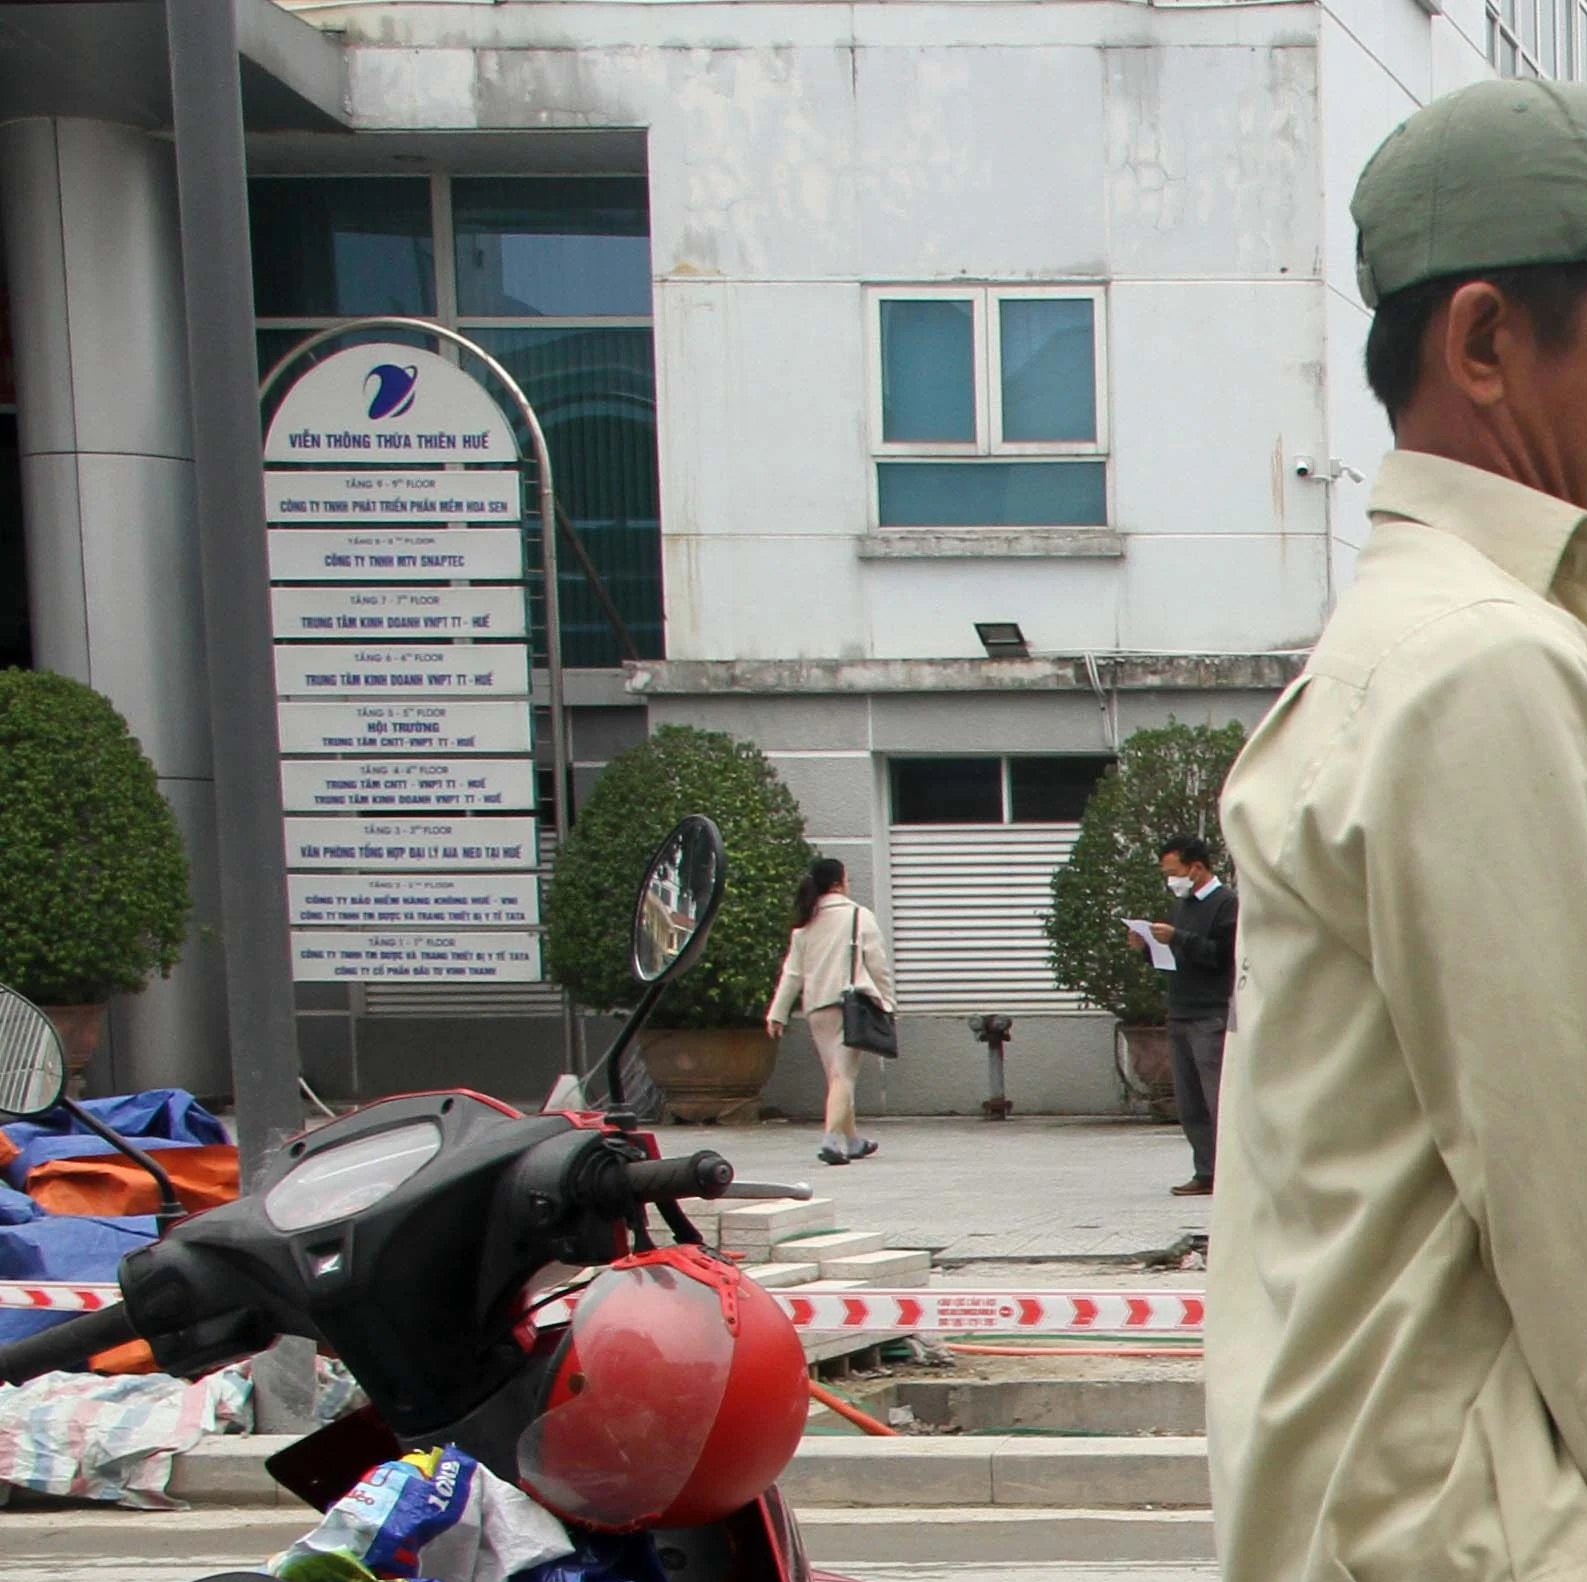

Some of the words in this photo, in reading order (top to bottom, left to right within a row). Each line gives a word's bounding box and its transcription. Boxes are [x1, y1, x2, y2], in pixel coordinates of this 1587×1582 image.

[290, 429, 320, 448] VIỄN
[326, 431, 371, 448] THÔNG
[377, 432, 412, 448] THỪA
[417, 431, 456, 448] THIÊN
[463, 430, 490, 448] HUẾ
[407, 480, 435, 488] FLOOR
[281, 498, 306, 512] CÔNG
[310, 501, 320, 512] TY
[324, 501, 348, 512] TNHH
[353, 497, 377, 512] PHÁT
[467, 501, 485, 512] HOA
[489, 501, 507, 512] SEN
[325, 553, 351, 567] CÔNG
[355, 555, 365, 567] TY
[370, 555, 394, 567] TNHH
[397, 555, 417, 567] MTV
[421, 555, 464, 567] SNAPTEC
[302, 617, 333, 628] TRUNG
[337, 614, 357, 628] TÂM
[360, 617, 384, 628] KINH
[388, 617, 420, 628] DOANH
[452, 617, 461, 628] TT
[473, 614, 490, 628] HUẾ
[306, 675, 336, 686] TRUNG
[341, 673, 361, 686] TÂM
[364, 675, 387, 686] KINH
[391, 675, 423, 686] DOANH
[428, 675, 451, 686] VNPT
[457, 675, 466, 686] TT
[475, 672, 493, 686] HUẾ
[368, 722, 387, 734] HỘI
[360, 843, 384, 858] TỔNG
